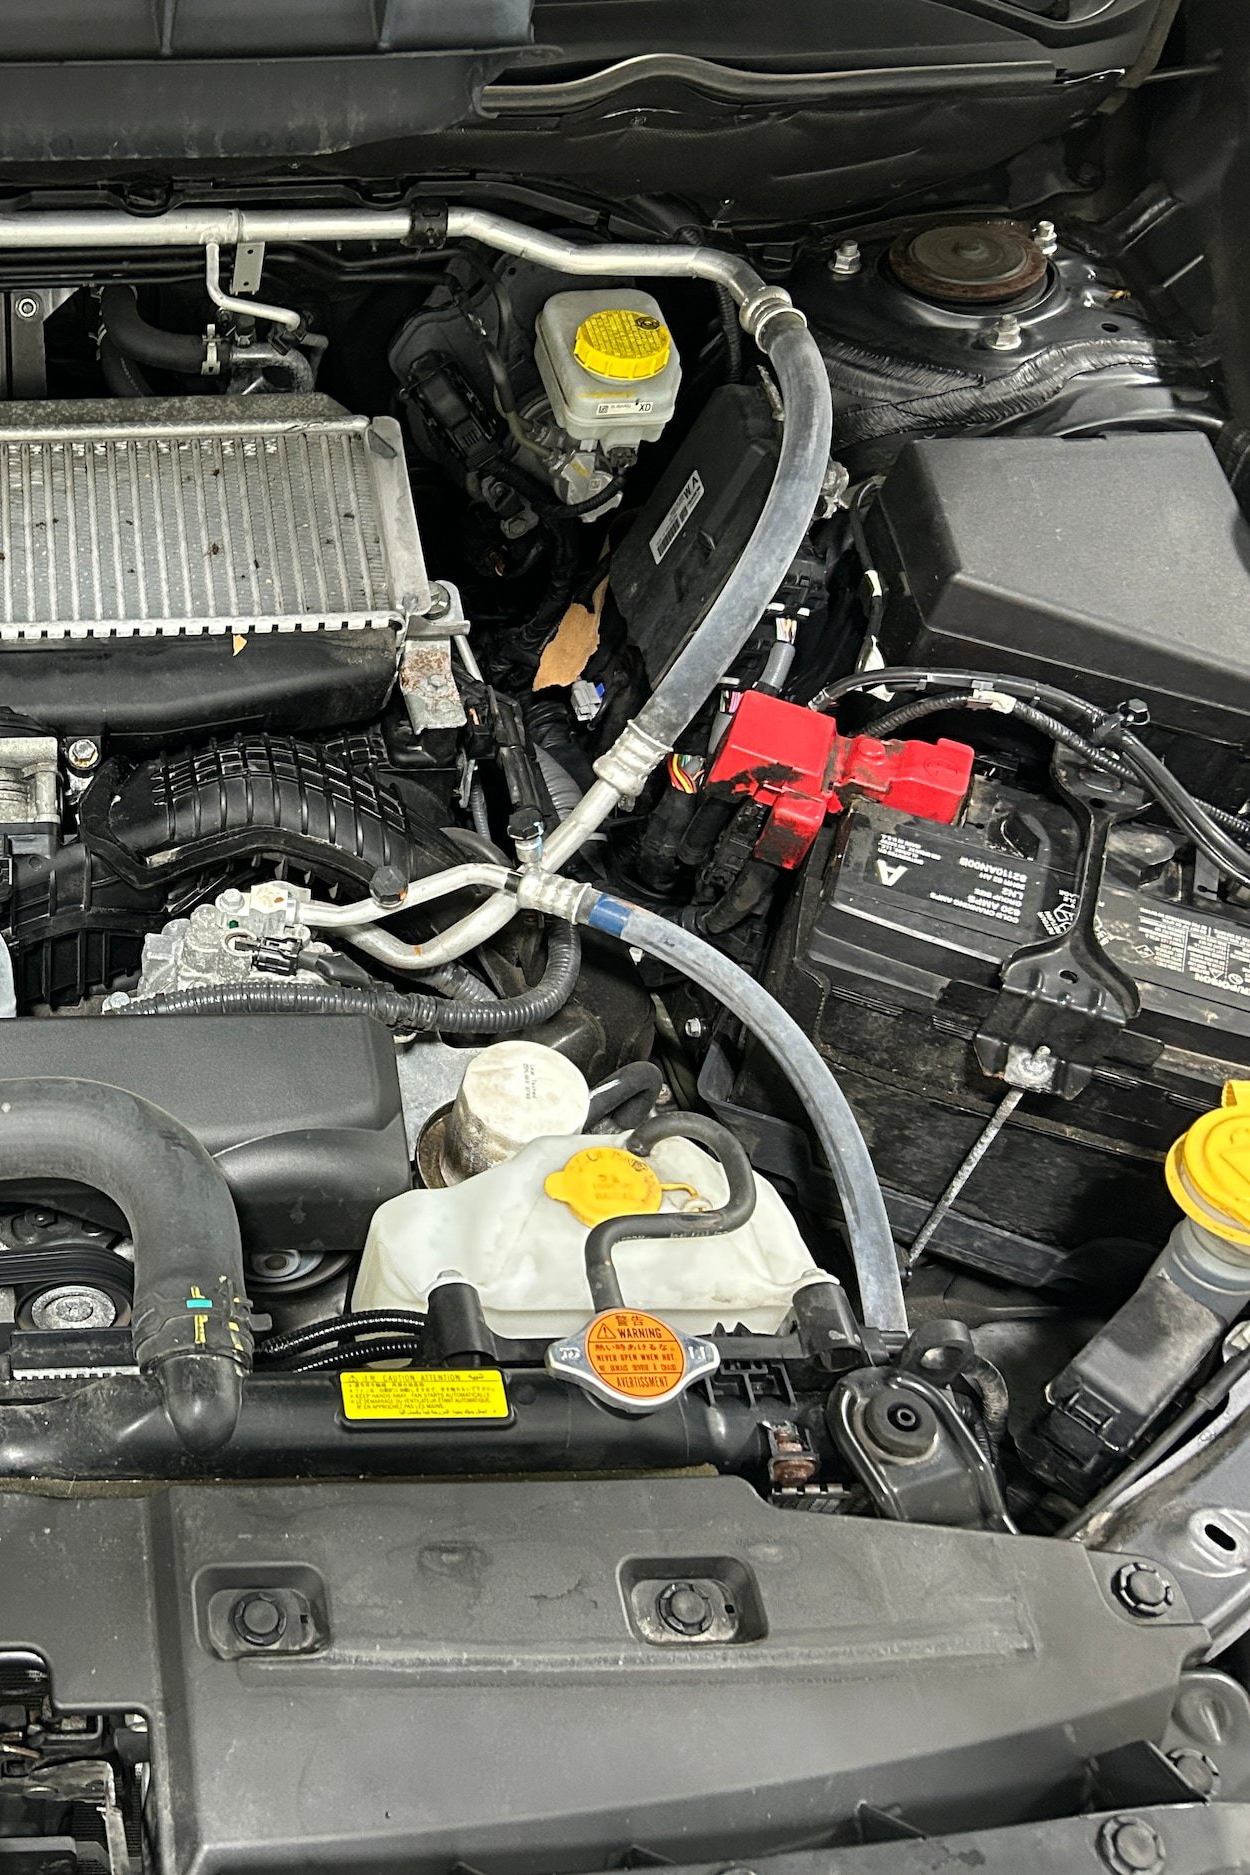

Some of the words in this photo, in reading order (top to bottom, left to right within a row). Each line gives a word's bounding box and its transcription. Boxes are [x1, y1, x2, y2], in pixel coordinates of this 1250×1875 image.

[639, 403, 652, 412] XD
[930, 891, 953, 904] AMPS
[1001, 887, 1024, 900] LN2
[967, 894, 1000, 910] AMPS
[992, 894, 1023, 908] GROUP
[953, 899, 996, 917] CRANKING
[1000, 904, 1021, 917] 620
[995, 911, 1020, 924] COLD
[615, 1315, 644, 1327] 警告
[617, 1327, 663, 1339] WARNING
[620, 1353, 638, 1361] OPEN
[640, 1353, 659, 1361] WHEN
[382, 1374, 415, 1382] CAUTION
[420, 1373, 461, 1381] ATTENTION
